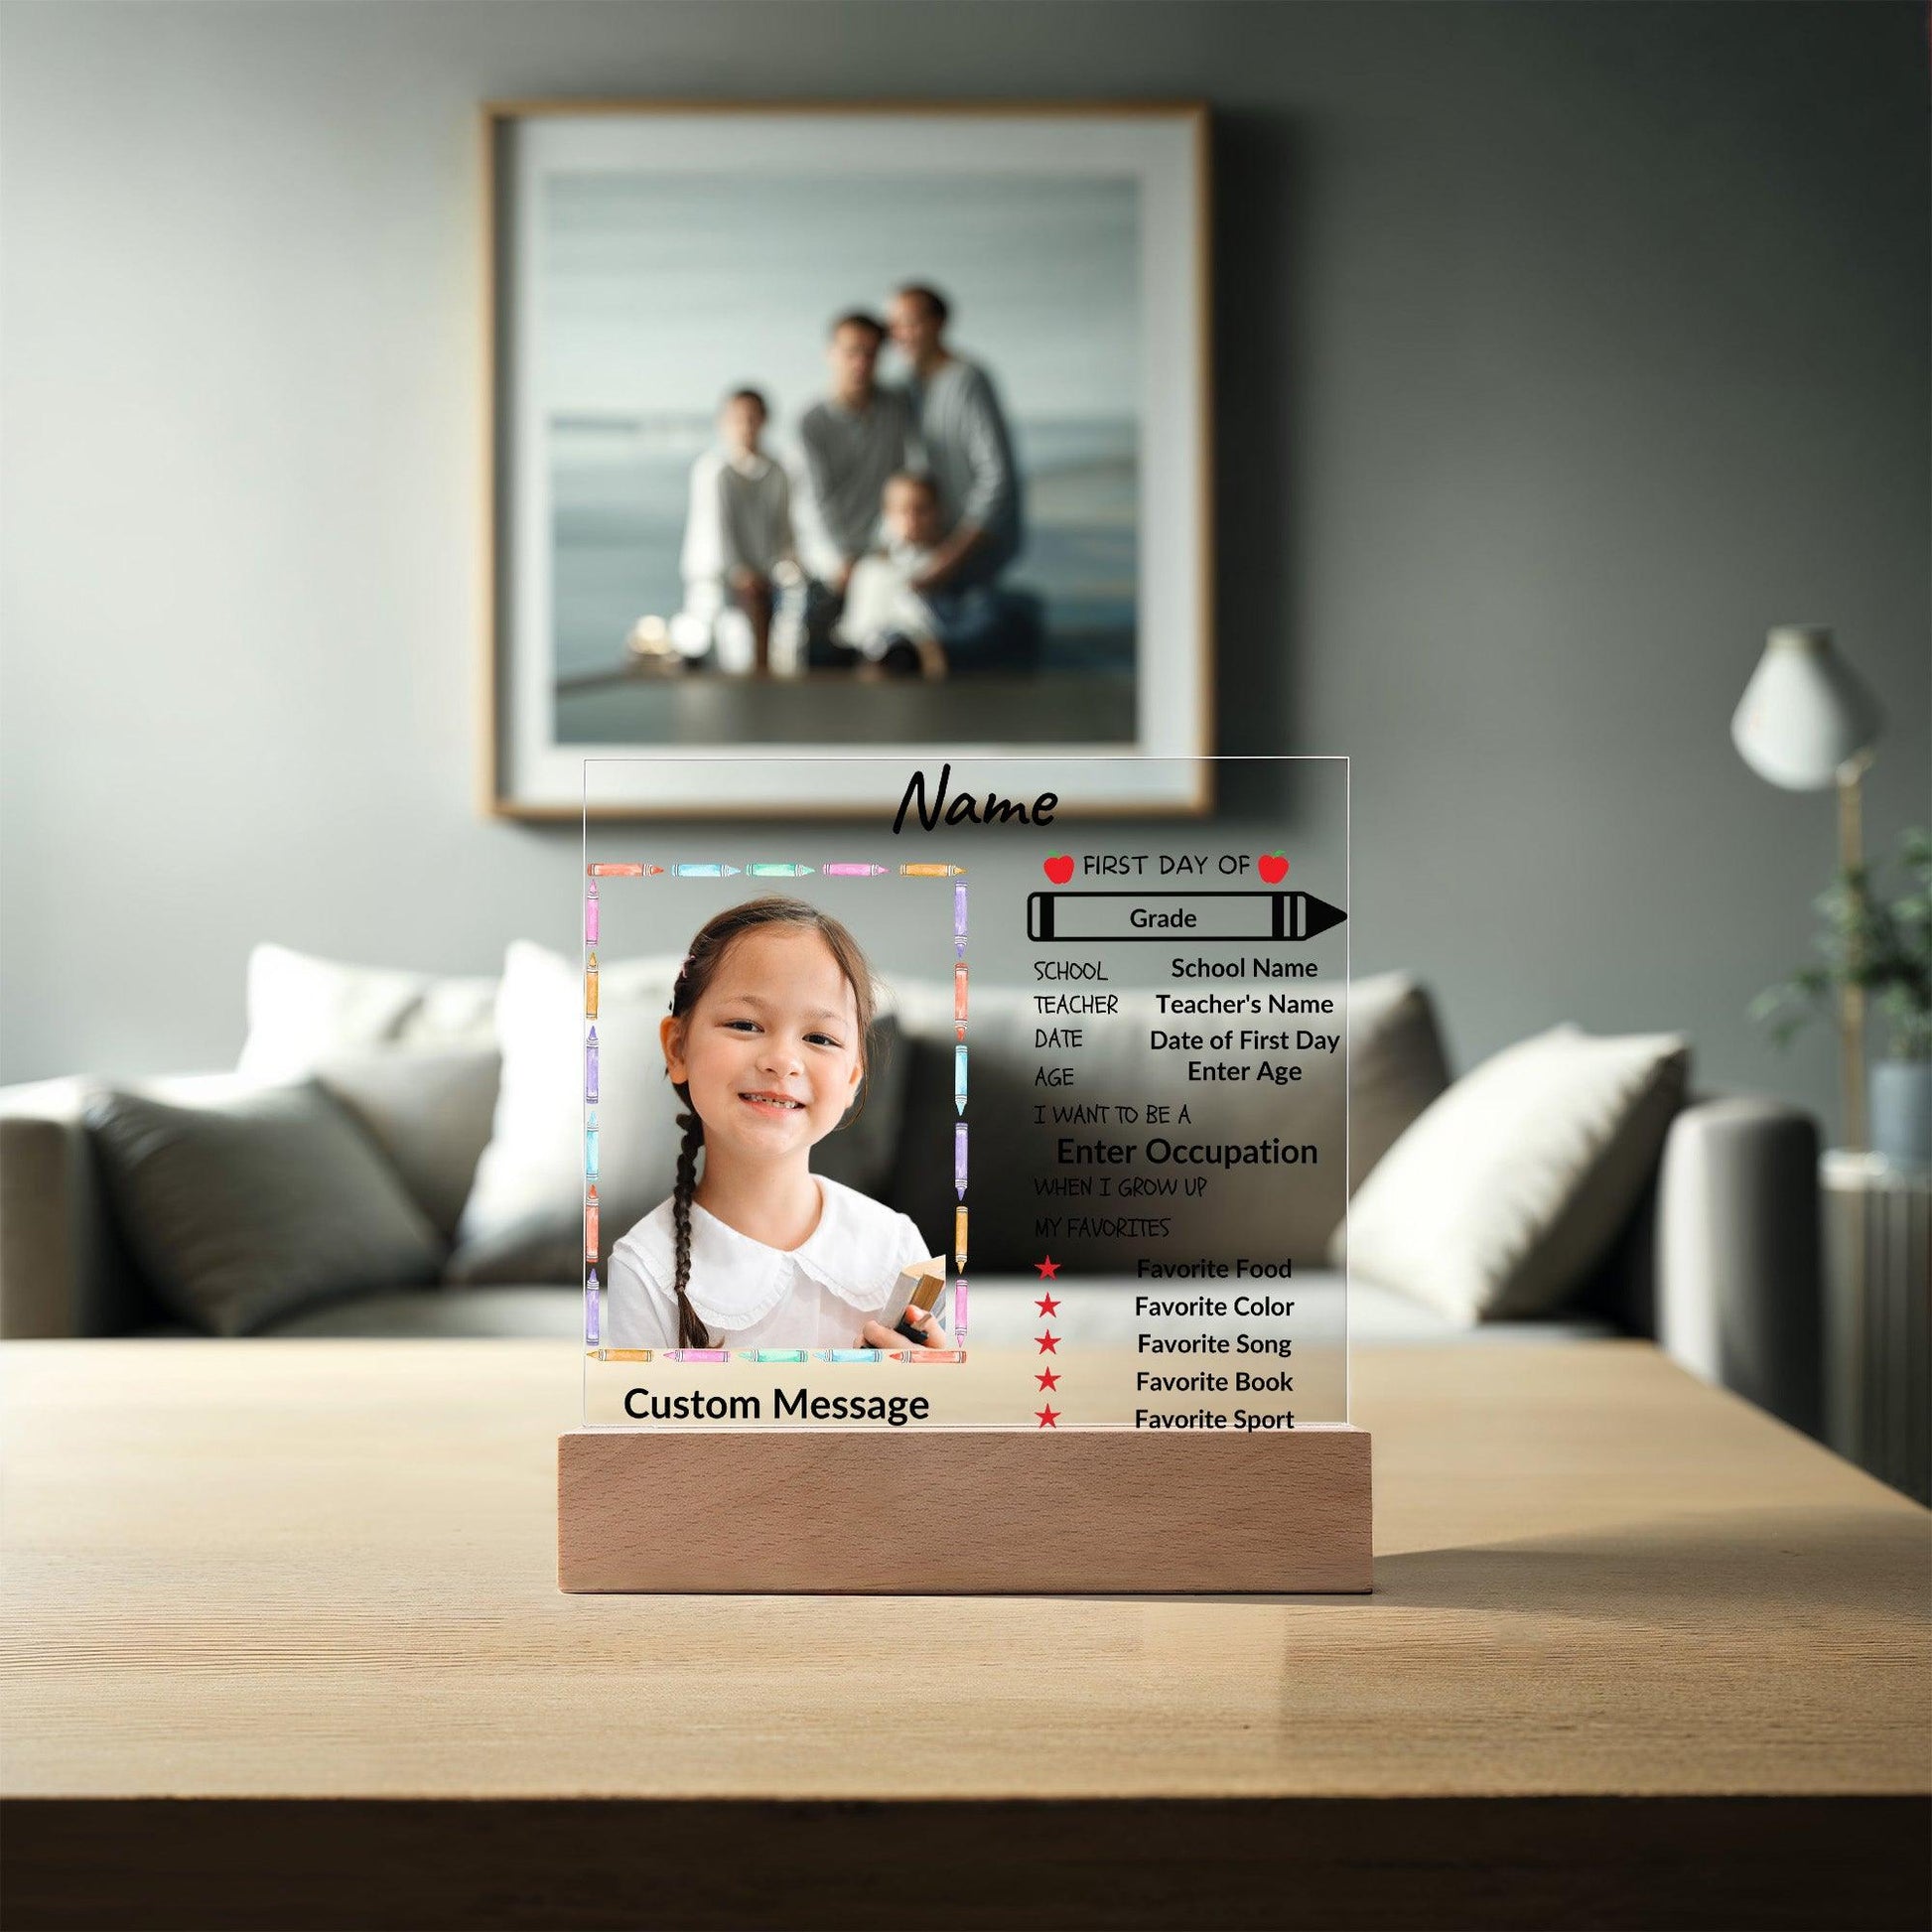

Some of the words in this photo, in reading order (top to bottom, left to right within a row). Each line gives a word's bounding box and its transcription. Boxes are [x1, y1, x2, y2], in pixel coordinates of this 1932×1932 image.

[893, 762, 1059, 835] Name
[1082, 855, 1149, 876] FIRST
[1160, 855, 1209, 876] DAY
[1218, 854, 1252, 876] OF
[1130, 907, 1197, 929] Grade
[1034, 960, 1109, 982] SCHOOL
[1172, 958, 1246, 978] School
[1252, 959, 1318, 978] Name
[1034, 995, 1119, 1015] TEACHER
[1156, 994, 1262, 1015] Teacher's
[1269, 995, 1334, 1015] Name
[1035, 1029, 1083, 1048] DATE
[1151, 1031, 1203, 1050] Date
[1209, 1030, 1234, 1050] of
[1240, 1030, 1290, 1050] First
[1297, 1031, 1340, 1054] Day
[1035, 1067, 1074, 1087] AGE
[1189, 1061, 1251, 1081] Enter
[1256, 1061, 1303, 1086] Age
[1034, 1105, 1046, 1125] I
[1052, 1104, 1110, 1124] WANT
[1115, 1106, 1139, 1124] TO
[1146, 1105, 1171, 1124] BE
[1178, 1104, 1191, 1124] A
[1057, 1139, 1137, 1165] Enter
[1146, 1138, 1318, 1170] Occupation
[1035, 1177, 1092, 1196] WHEN
[1099, 1177, 1112, 1196] I
[1119, 1177, 1177, 1197] GROW
[1184, 1176, 1207, 1197] UP
[1035, 1217, 1062, 1238] MY
[1068, 1217, 1172, 1238] FAVORITES
[1137, 1259, 1229, 1279] Favorite
[1237, 1258, 1293, 1279] Food
[1135, 1297, 1227, 1316] Favorite
[1234, 1296, 1295, 1316] Color
[1138, 1333, 1230, 1354] Favorite
[1236, 1333, 1292, 1358] Song
[1137, 1371, 1228, 1392] Favorite
[1236, 1371, 1294, 1392] Book
[624, 1388, 760, 1420] Custom
[774, 1388, 929, 1427] Message
[1135, 1409, 1227, 1430] Favorite
[1234, 1409, 1295, 1433] Sport
